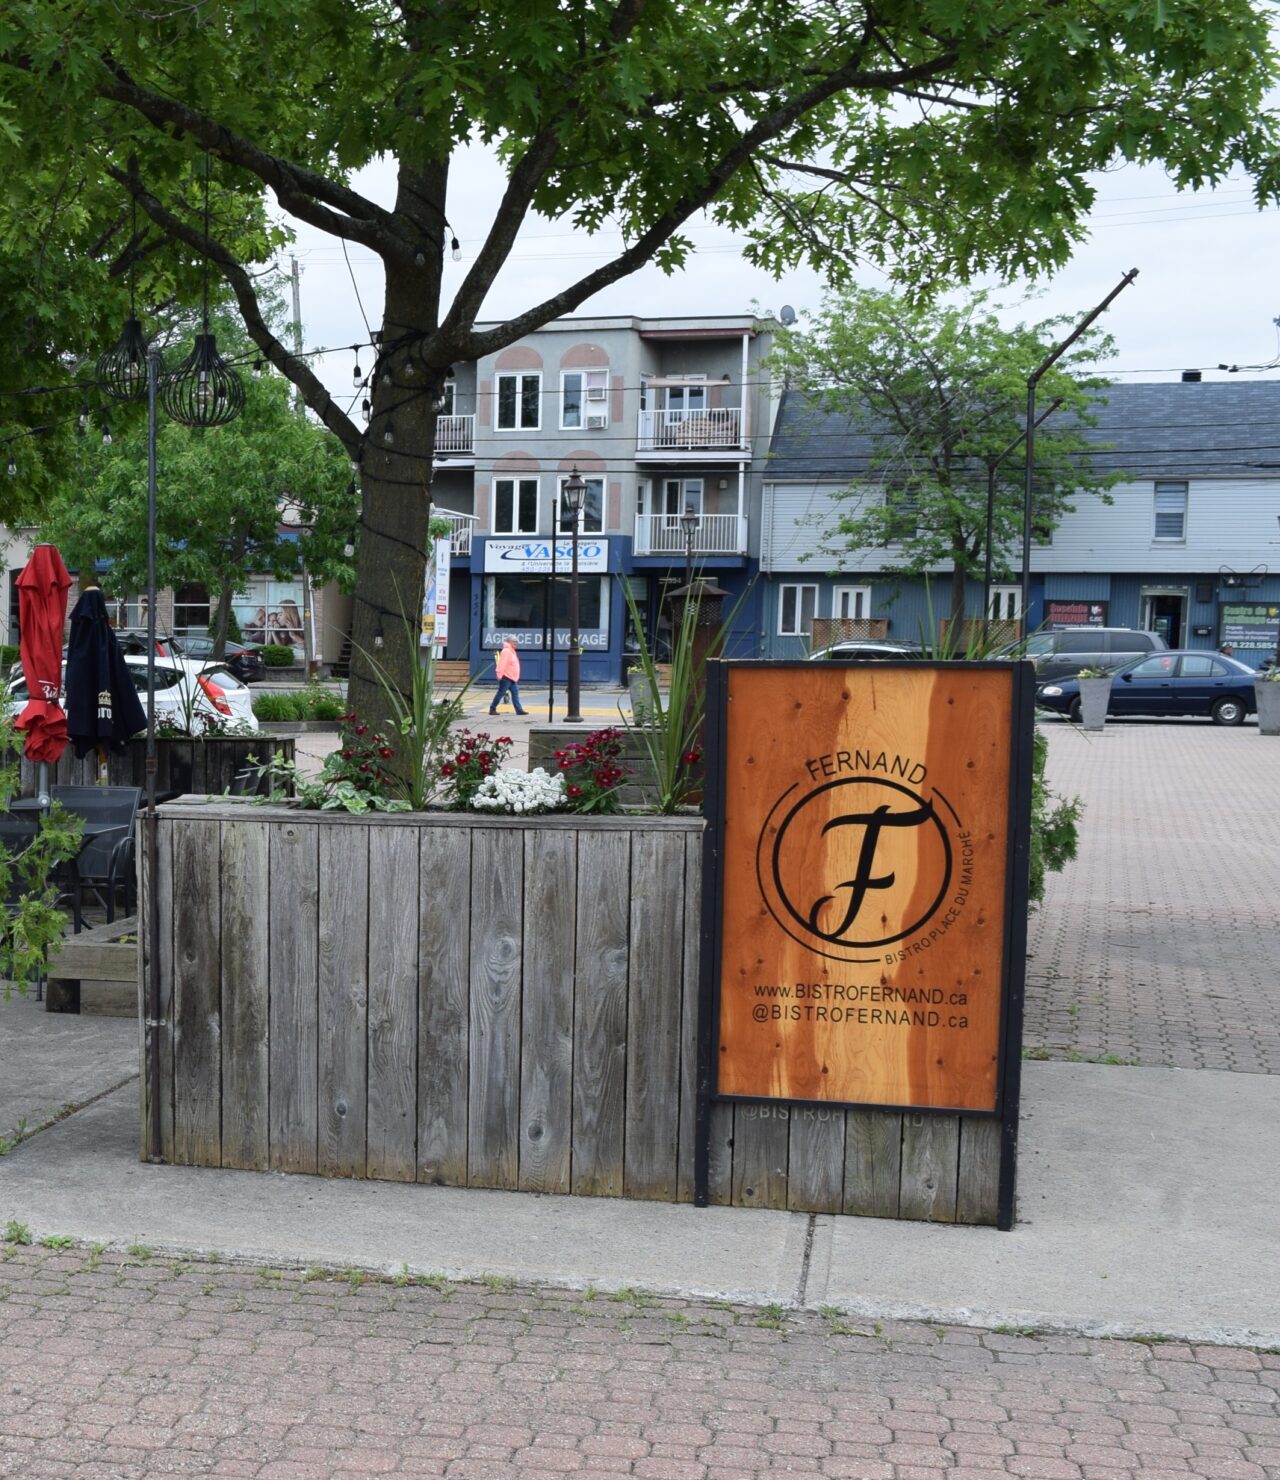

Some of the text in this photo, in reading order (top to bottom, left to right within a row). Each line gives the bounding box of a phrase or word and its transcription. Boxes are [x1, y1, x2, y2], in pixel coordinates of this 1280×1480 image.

[522, 544, 601, 558] VASCO
[484, 632, 532, 644] AGECE
[557, 634, 607, 645] VOAGE
[805, 749, 928, 785] FERNAND
[809, 798, 933, 939] F
[884, 830, 974, 965] BISTRO PLACE DU MARCHÉ
[754, 983, 968, 1006] www.BISTROFERNAND.ca
[752, 1003, 969, 1028] @BISTROFERNAND.ca
